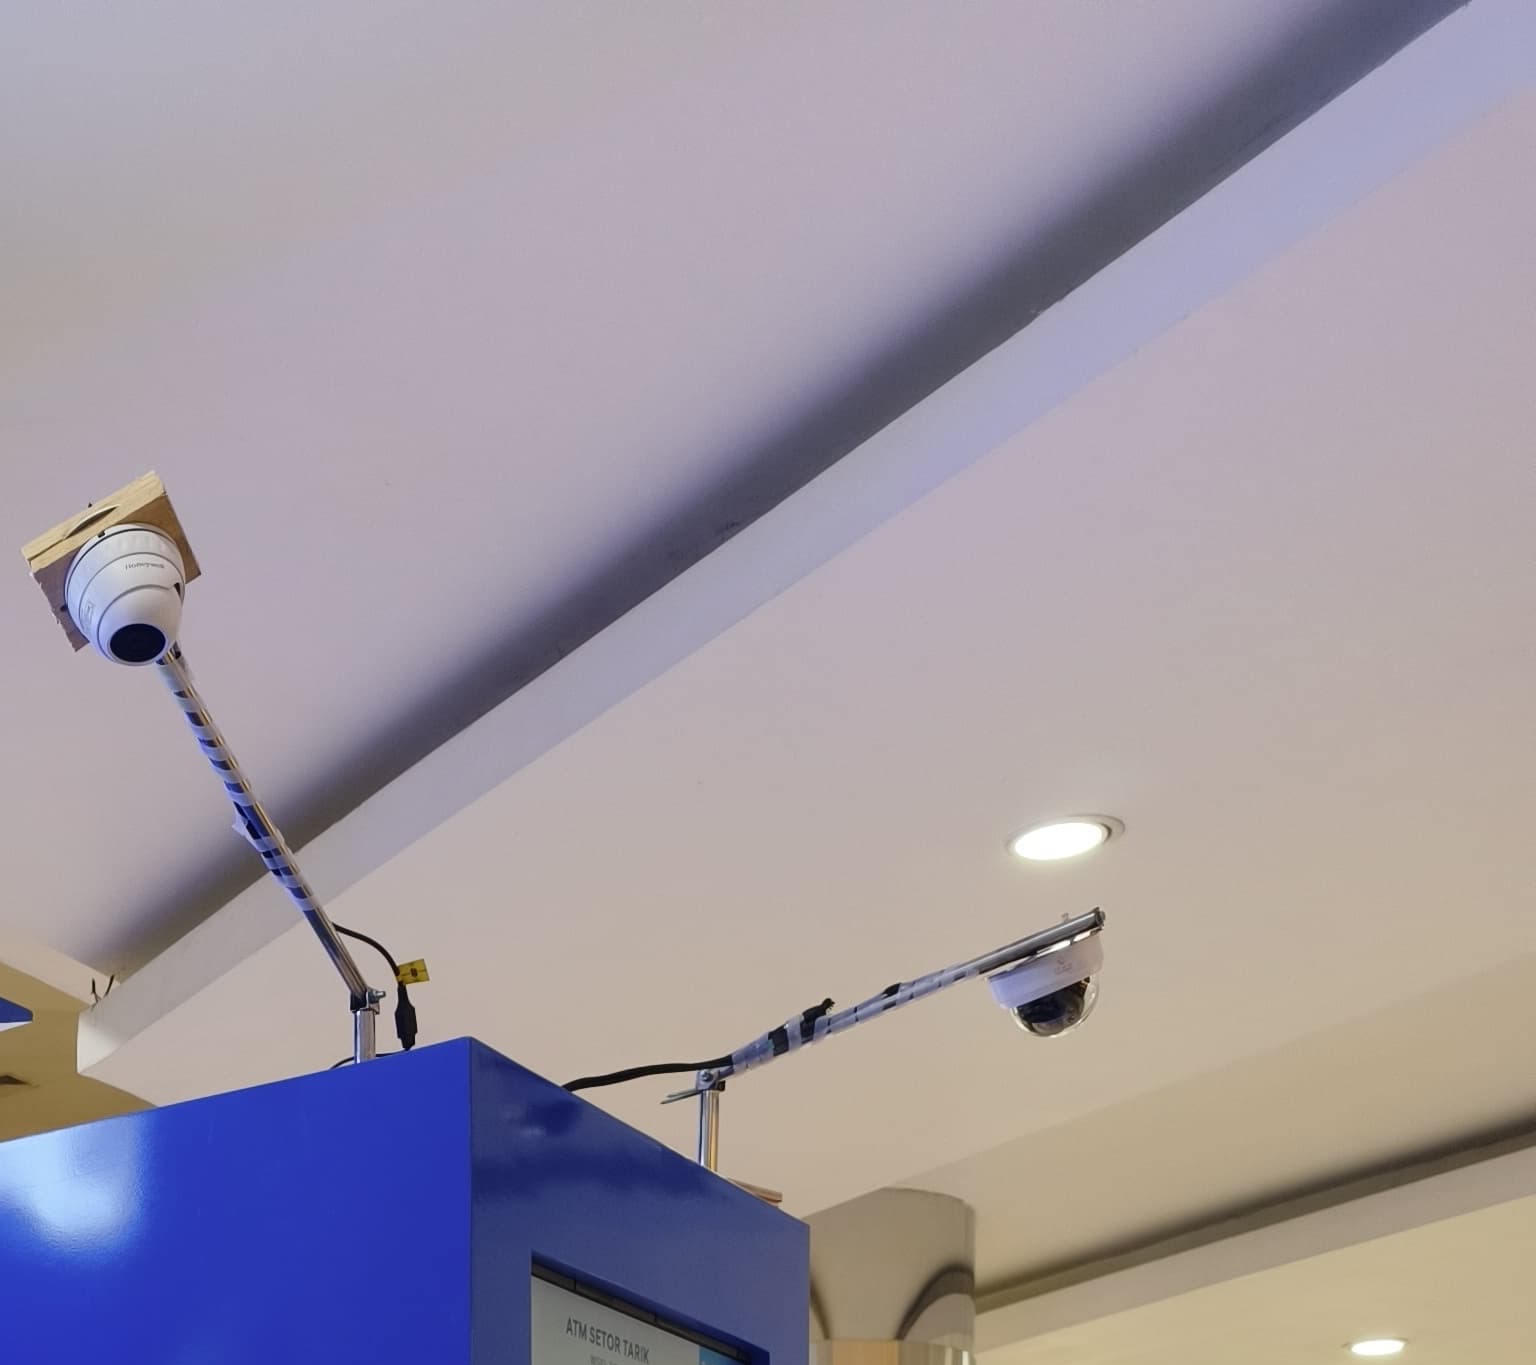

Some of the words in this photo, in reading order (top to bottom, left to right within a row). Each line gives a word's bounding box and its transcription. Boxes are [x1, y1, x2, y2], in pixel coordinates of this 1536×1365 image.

[565, 1316, 588, 1341] ATM
[589, 1325, 621, 1354] SETOR
[623, 1338, 650, 1364] TARIK
